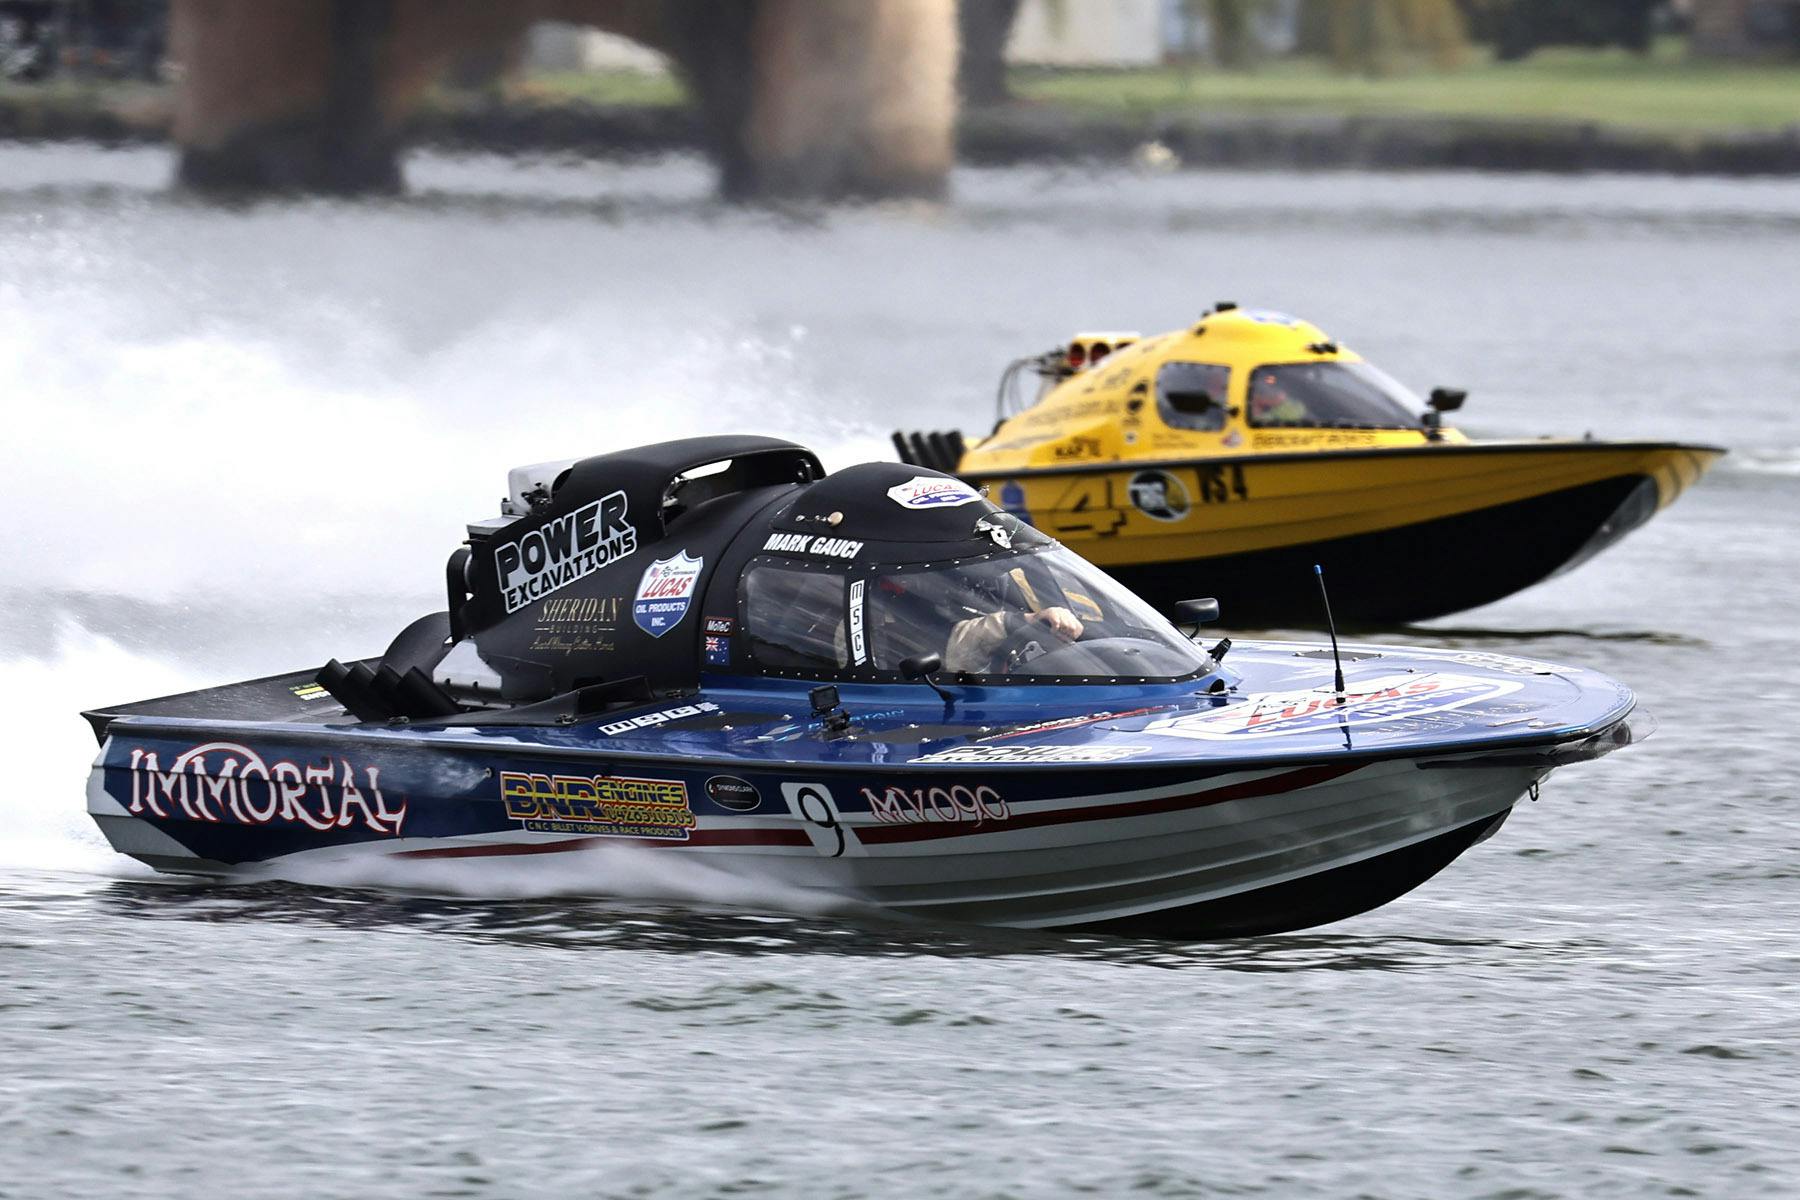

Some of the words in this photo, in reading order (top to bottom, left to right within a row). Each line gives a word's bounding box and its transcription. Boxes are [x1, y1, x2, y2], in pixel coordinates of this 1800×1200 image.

[498, 492, 627, 588] POWER
[763, 533, 812, 552] MARK
[810, 536, 864, 559] GAUCI
[507, 531, 635, 611] EXCAVATIONS
[642, 577, 693, 598] LUCAS
[636, 604, 647, 614] OIL
[649, 602, 686, 613] PRODUCTS
[651, 617, 665, 627] INC.
[707, 620, 731, 632] MoTeC
[129, 741, 406, 834] IMMORTAL
[597, 782, 684, 804] ENGINES
[552, 823, 575, 832] BILLET
[576, 824, 611, 835] V-DRIVES
[620, 827, 640, 836] RACE
[641, 828, 683, 837] PRODUCTS
[797, 787, 846, 857] 9
